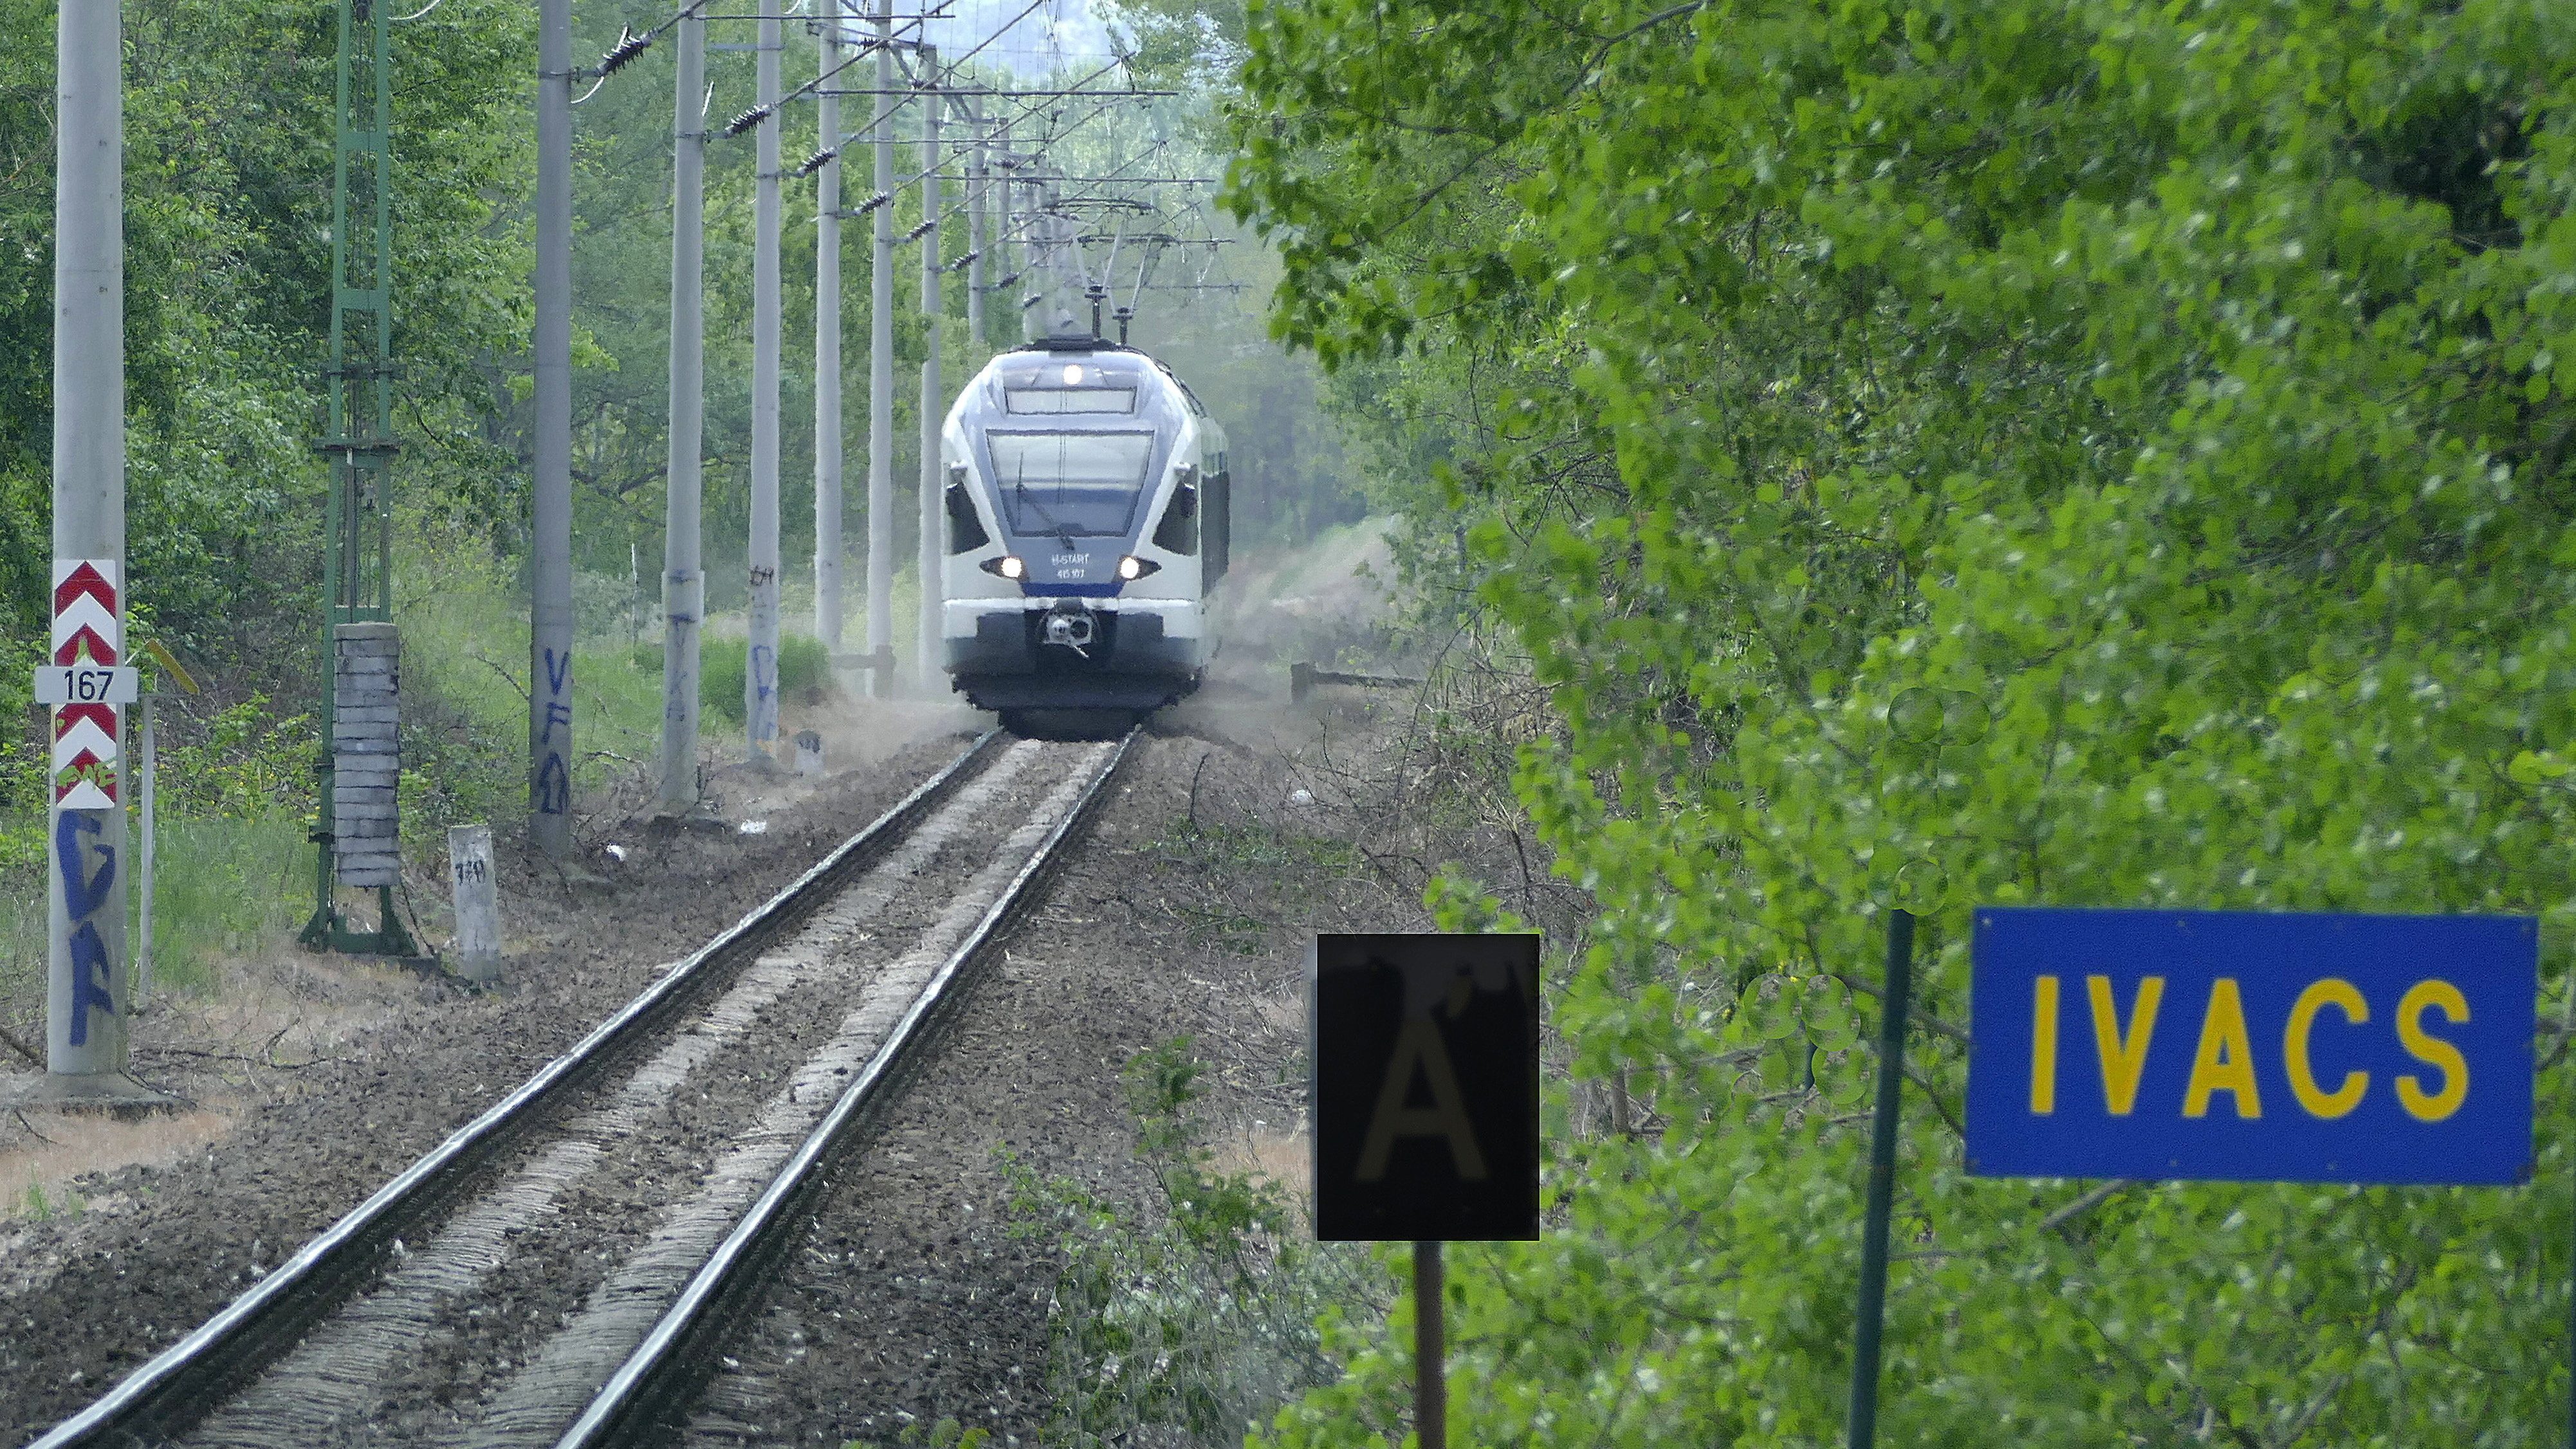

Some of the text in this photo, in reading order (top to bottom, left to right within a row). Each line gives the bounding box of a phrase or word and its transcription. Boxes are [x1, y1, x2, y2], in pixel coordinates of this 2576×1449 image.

[64, 670, 113, 701] 167
[1355, 1019, 1489, 1181] A
[2031, 975, 2470, 1121] IVACS
